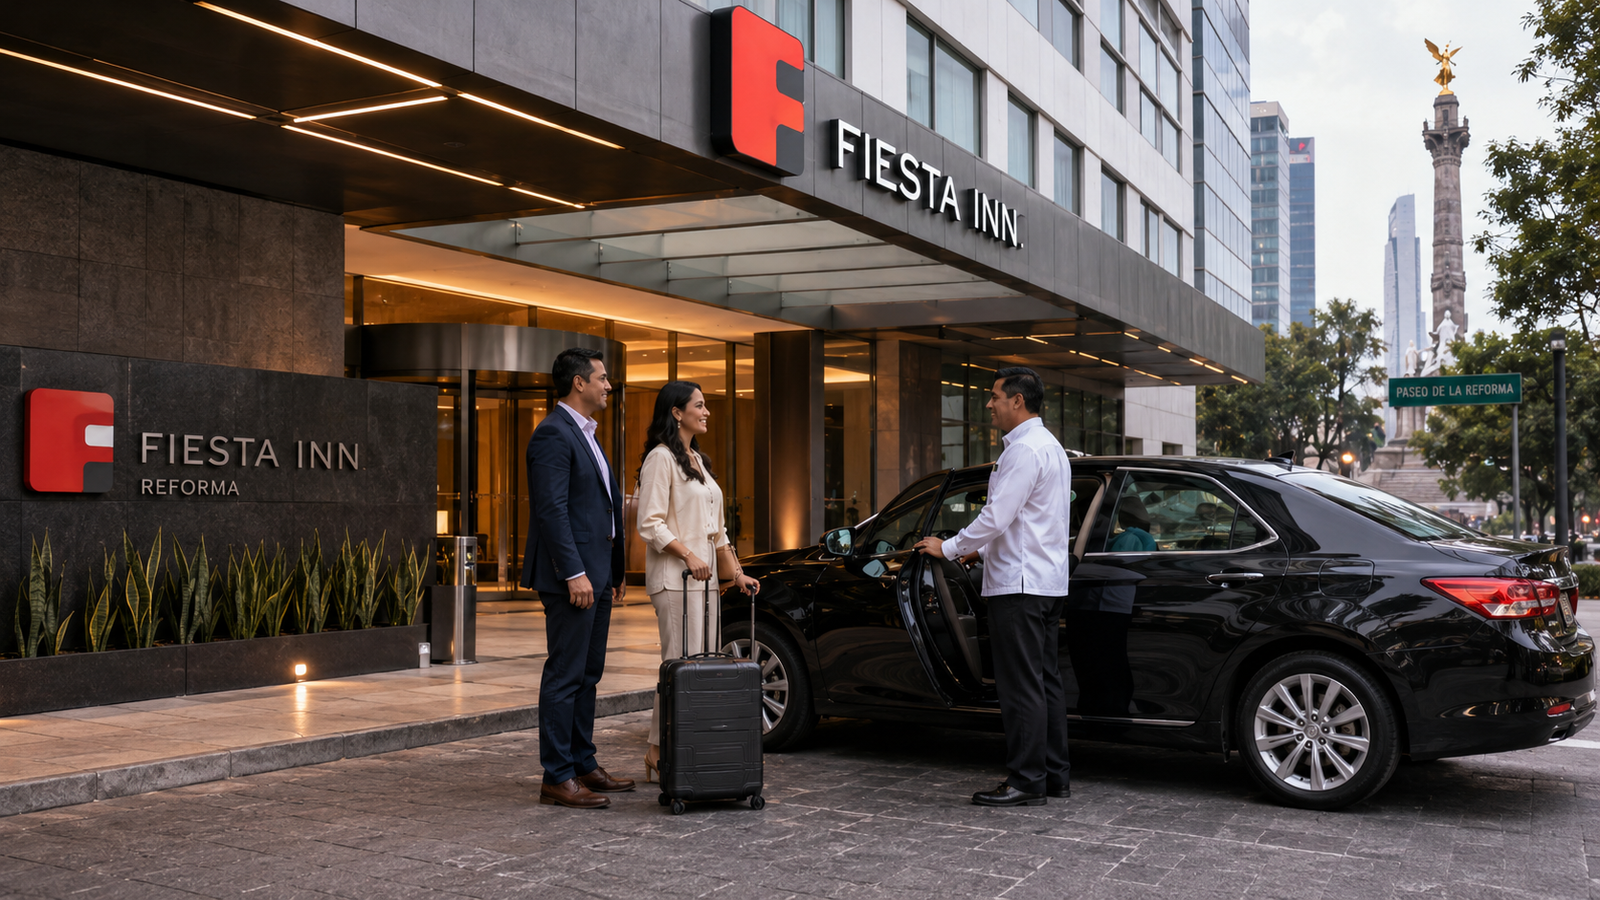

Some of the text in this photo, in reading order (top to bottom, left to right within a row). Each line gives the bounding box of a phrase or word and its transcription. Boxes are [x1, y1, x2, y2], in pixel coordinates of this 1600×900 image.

[832, 118, 961, 222] FIESTA
[1396, 383, 1514, 398] PASEO DE LA REFORMA
[141, 432, 280, 468] FIESTA
[141, 478, 240, 496] REFORMA
